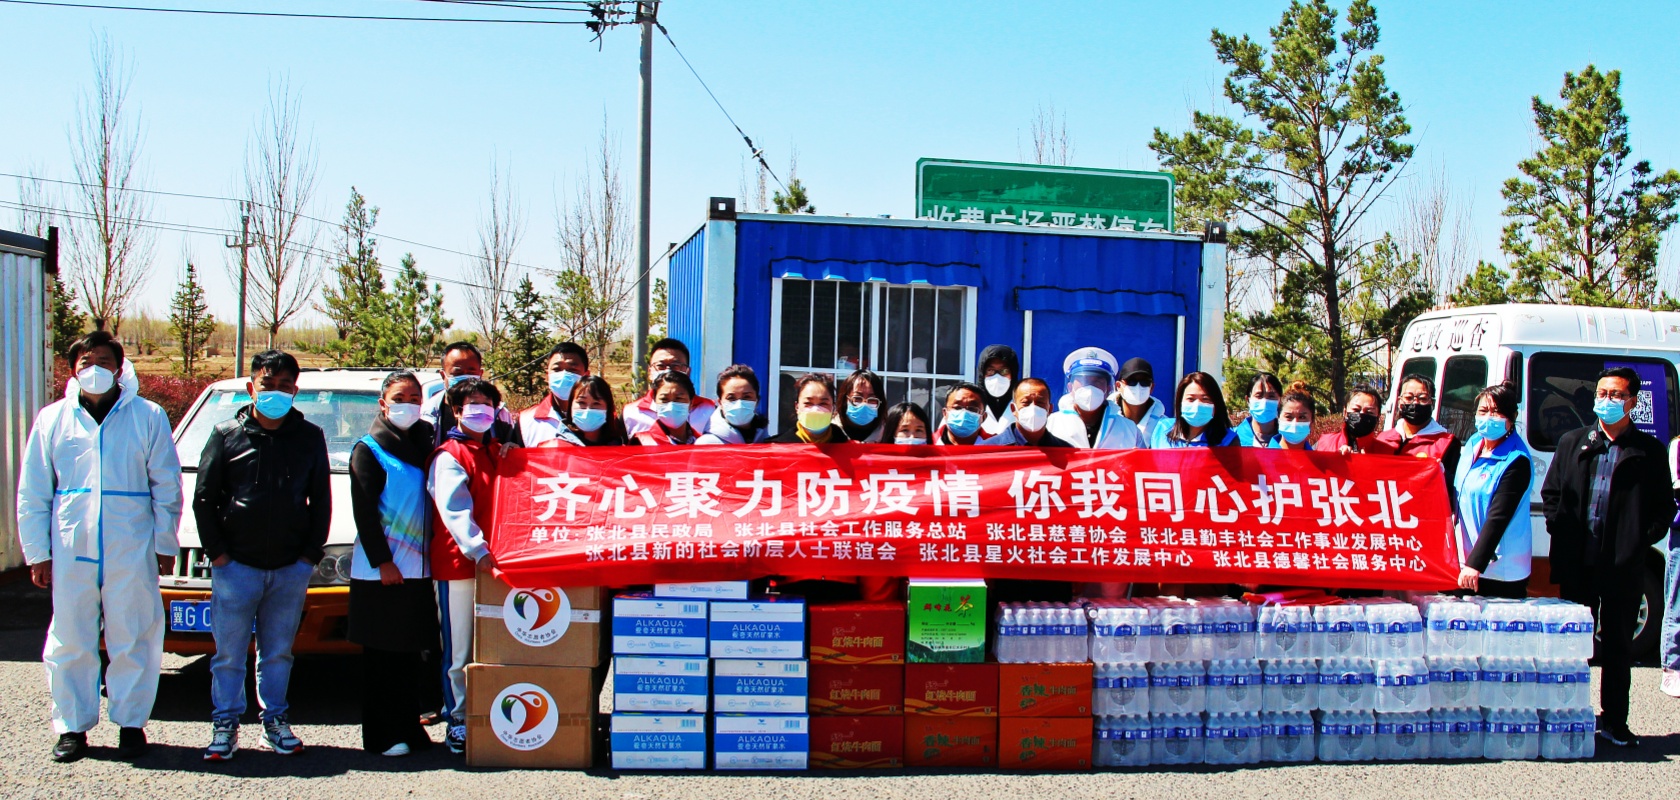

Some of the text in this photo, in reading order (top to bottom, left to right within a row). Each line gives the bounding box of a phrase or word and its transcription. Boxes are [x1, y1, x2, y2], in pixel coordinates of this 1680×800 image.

[1410, 317, 1488, 353] 运政巡查
[532, 468, 1419, 529] 齐心聚力防疫情 你我同心护张北
[734, 520, 967, 540] 张北县社会工作服务总站
[986, 523, 1127, 544] 张北县慈善协会
[1140, 527, 1423, 551] 张北县勤丰社会工作事业发展中心
[585, 540, 1427, 572] 张北县新的社会阶层人士联谊会 张北县星火社会工作发展中心 张北县德馨社会服务中心
[635, 619, 685, 627] ALKAQUA
[732, 623, 781, 631] ALKAQUA
[637, 677, 686, 685] ALKAQUA
[736, 678, 785, 686] ALKAQUA
[633, 734, 682, 742] ALKAQUA
[737, 735, 786, 743] ALKAQUA
